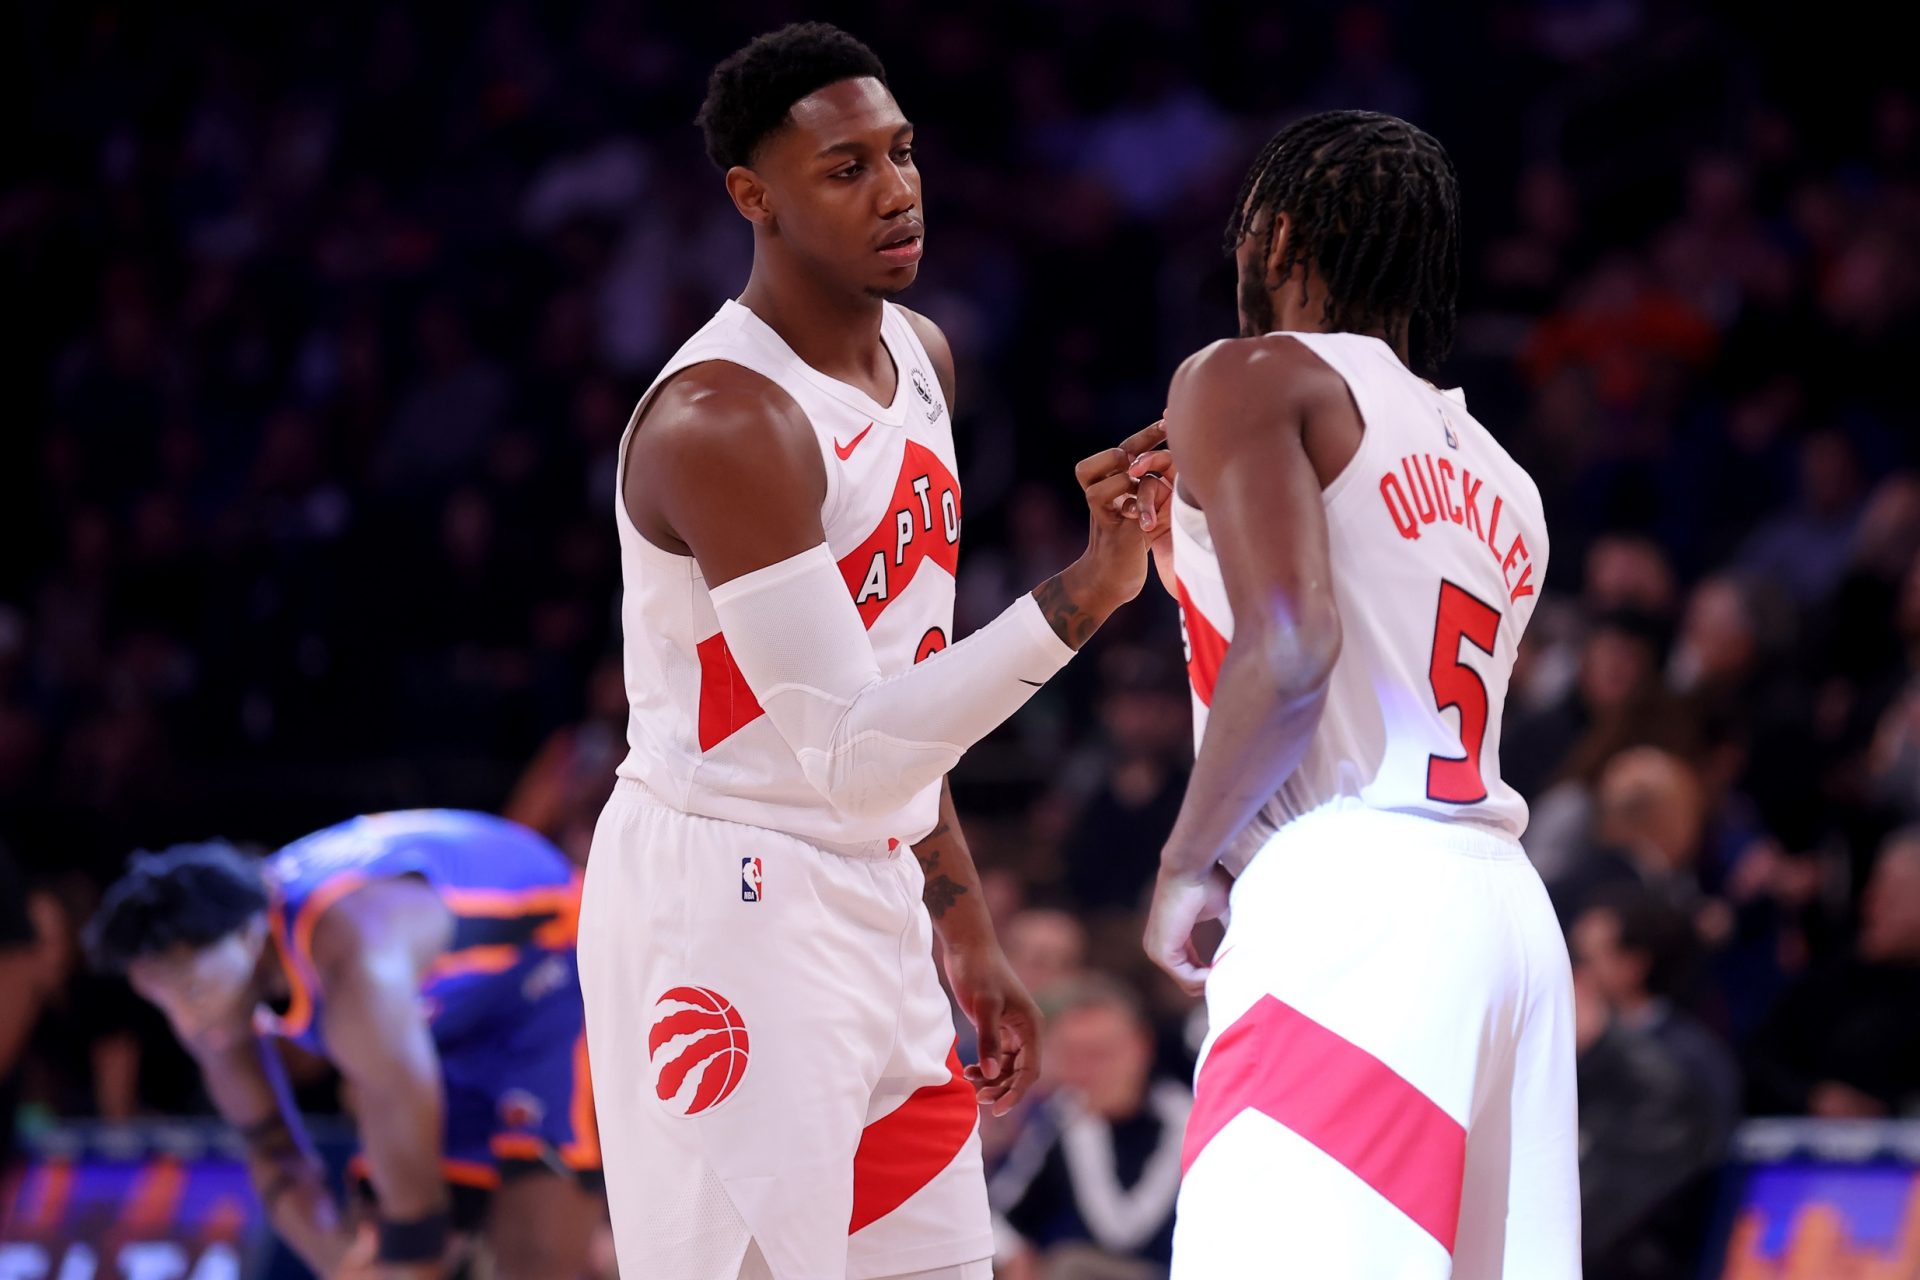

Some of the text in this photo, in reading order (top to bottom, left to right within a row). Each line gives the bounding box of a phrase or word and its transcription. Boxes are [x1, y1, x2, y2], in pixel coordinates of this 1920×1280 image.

[856, 474, 961, 604] APTO
[1380, 453, 1534, 605] QUICKLEY
[1427, 577, 1502, 804] 5
